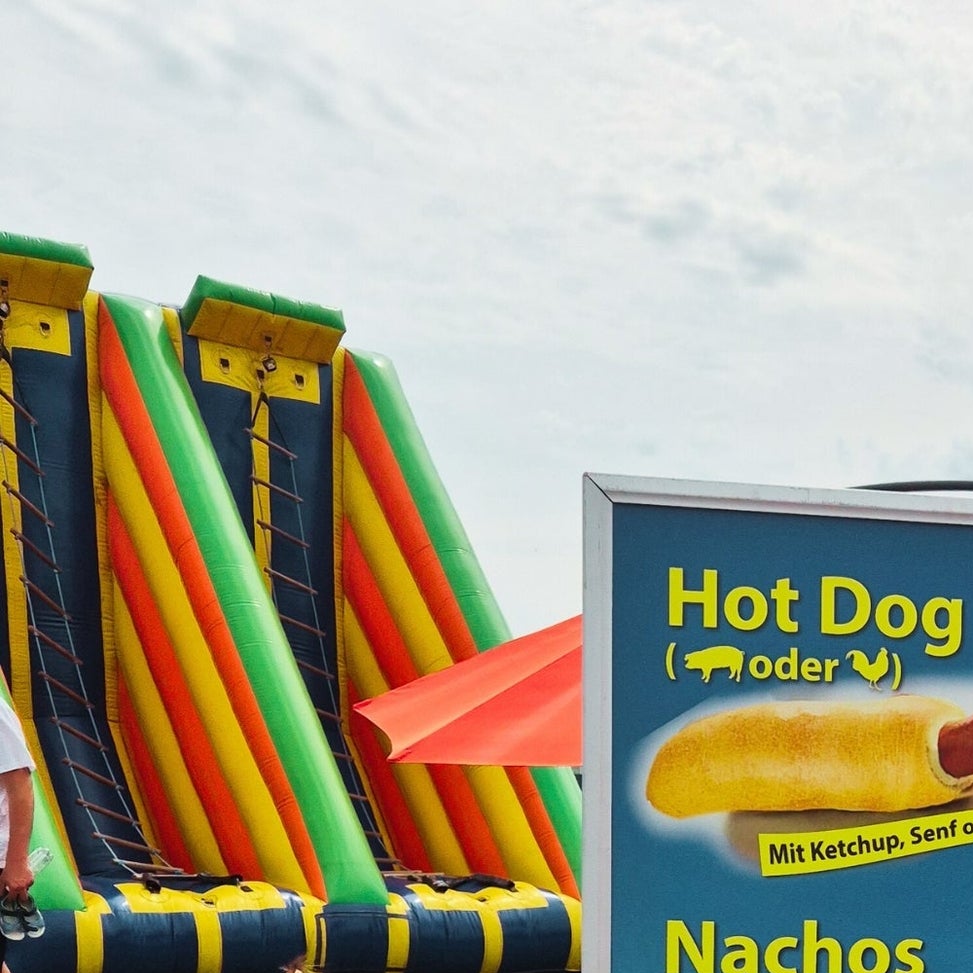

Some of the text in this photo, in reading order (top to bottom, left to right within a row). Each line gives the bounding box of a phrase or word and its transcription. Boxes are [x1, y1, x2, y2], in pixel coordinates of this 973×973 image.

[668, 567, 963, 657] Hot Dog
[749, 647, 839, 682] oder
[769, 843, 805, 865] Mit
[810, 832, 905, 862] Ketchup,
[910, 819, 957, 845] Senf
